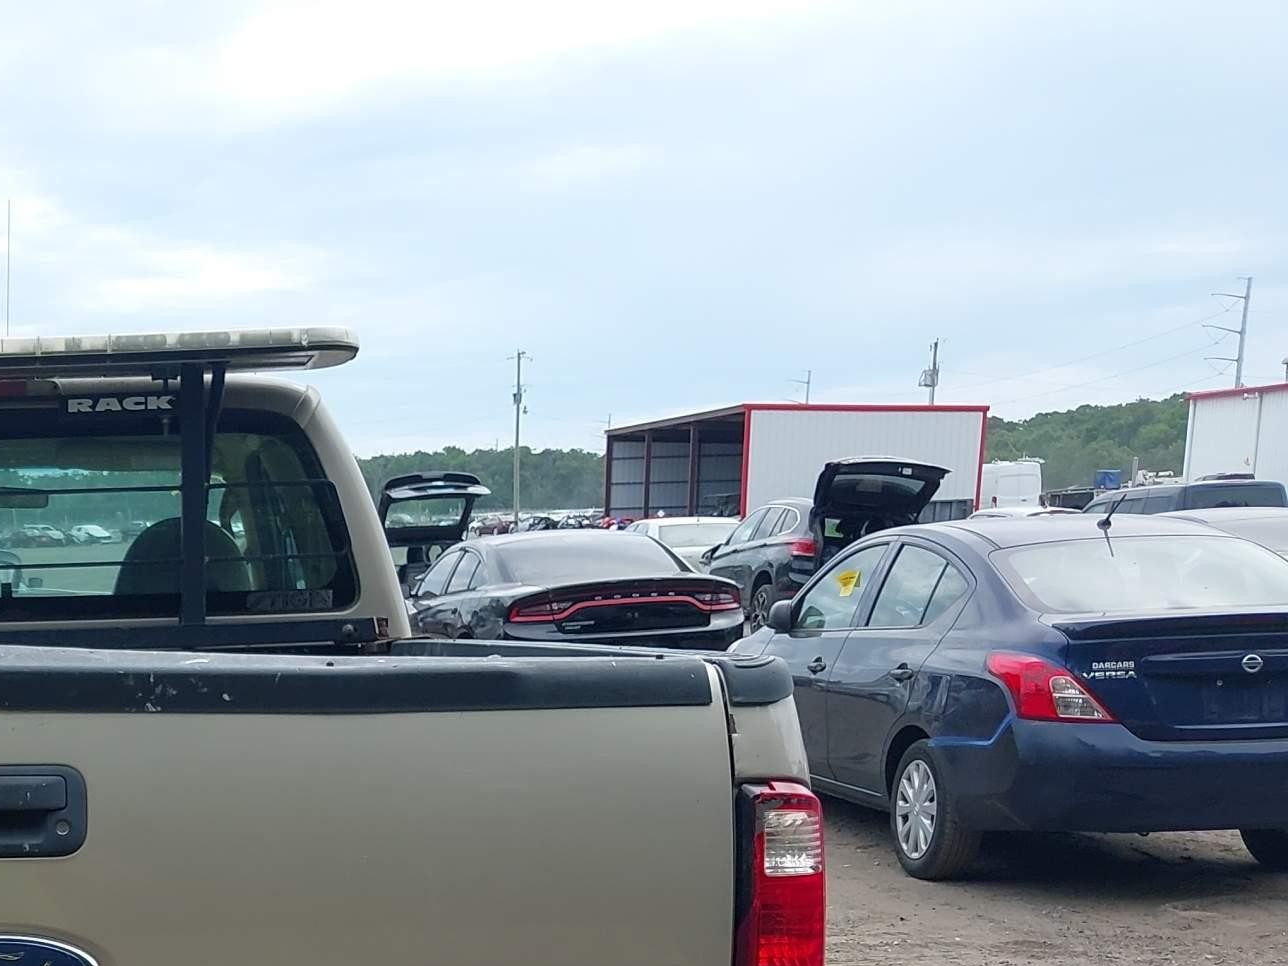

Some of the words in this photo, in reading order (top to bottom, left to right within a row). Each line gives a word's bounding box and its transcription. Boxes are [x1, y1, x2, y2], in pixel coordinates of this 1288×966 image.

[68, 396, 174, 413] RACK
[1092, 660, 1135, 669] DARCARS
[1082, 670, 1137, 680] VERSA
